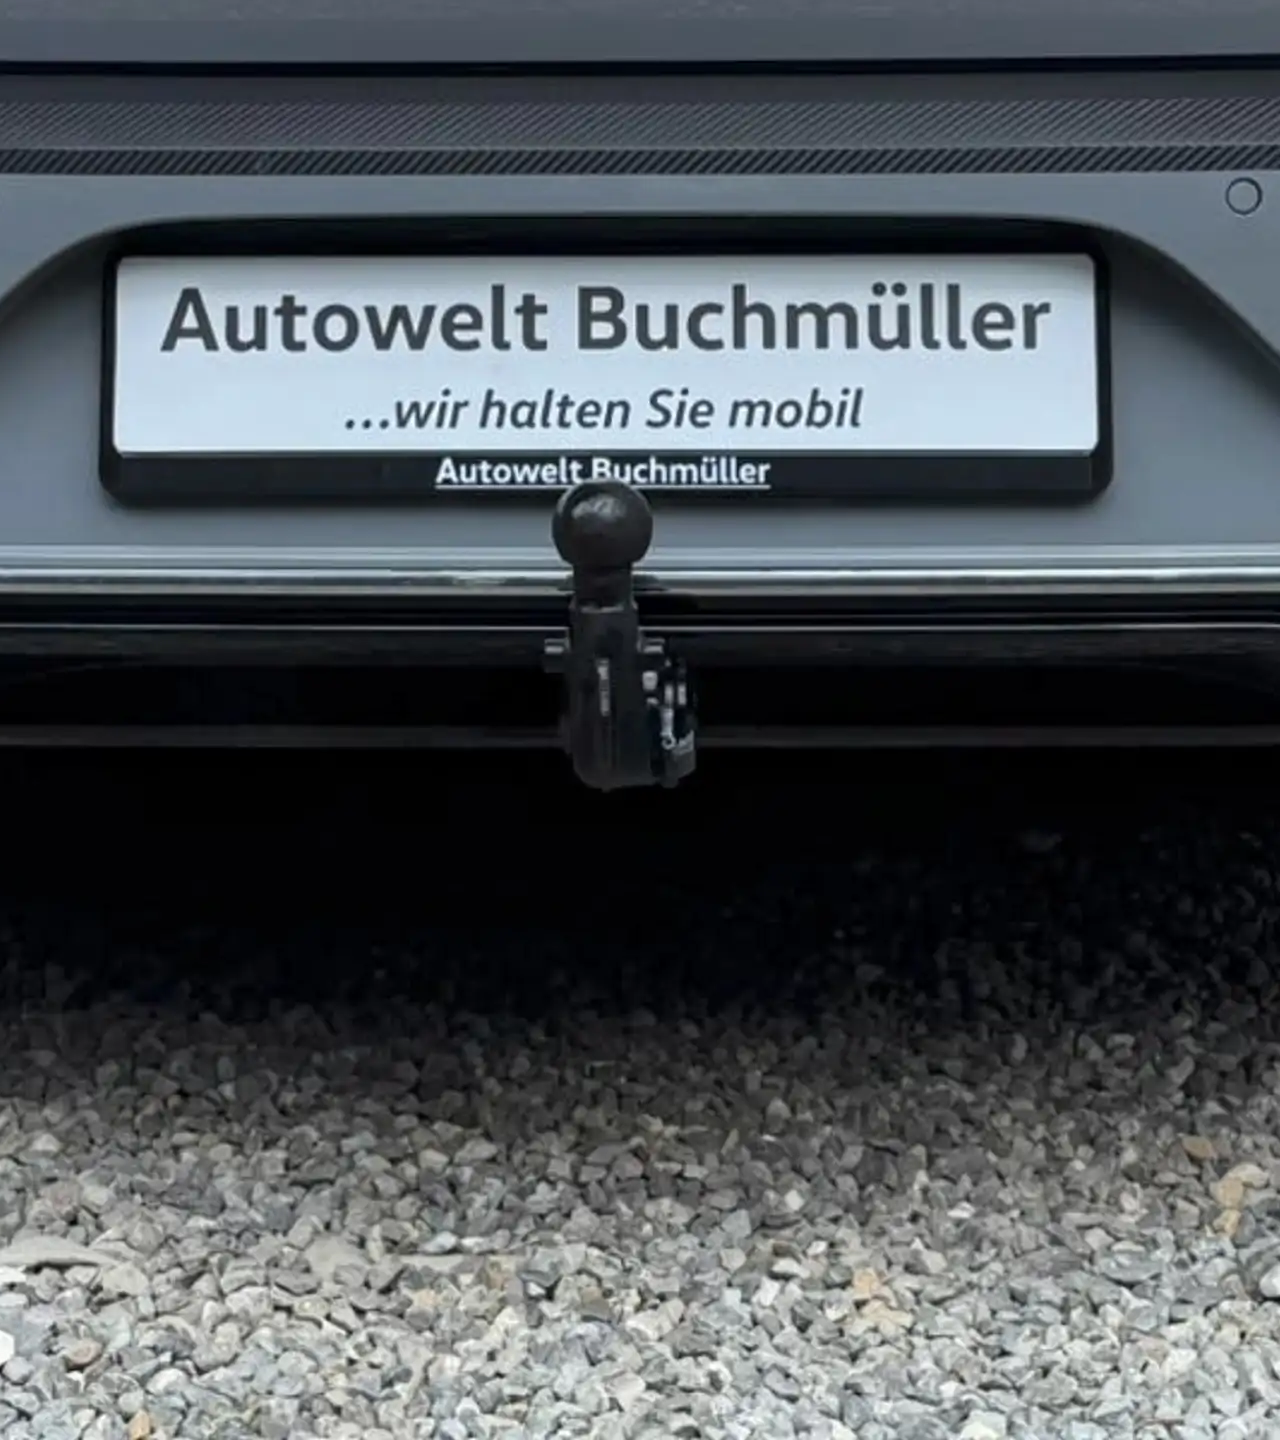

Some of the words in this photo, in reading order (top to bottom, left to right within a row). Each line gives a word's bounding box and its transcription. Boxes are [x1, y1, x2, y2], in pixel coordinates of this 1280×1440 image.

[160, 284, 549, 353] Autowelt
[576, 282, 1052, 352] Buchmüller
[478, 389, 631, 430] halten
[645, 390, 715, 429] Sie
[727, 387, 863, 429] mobil
[434, 456, 584, 485] Autowelt
[590, 455, 772, 485] Buchmüller
